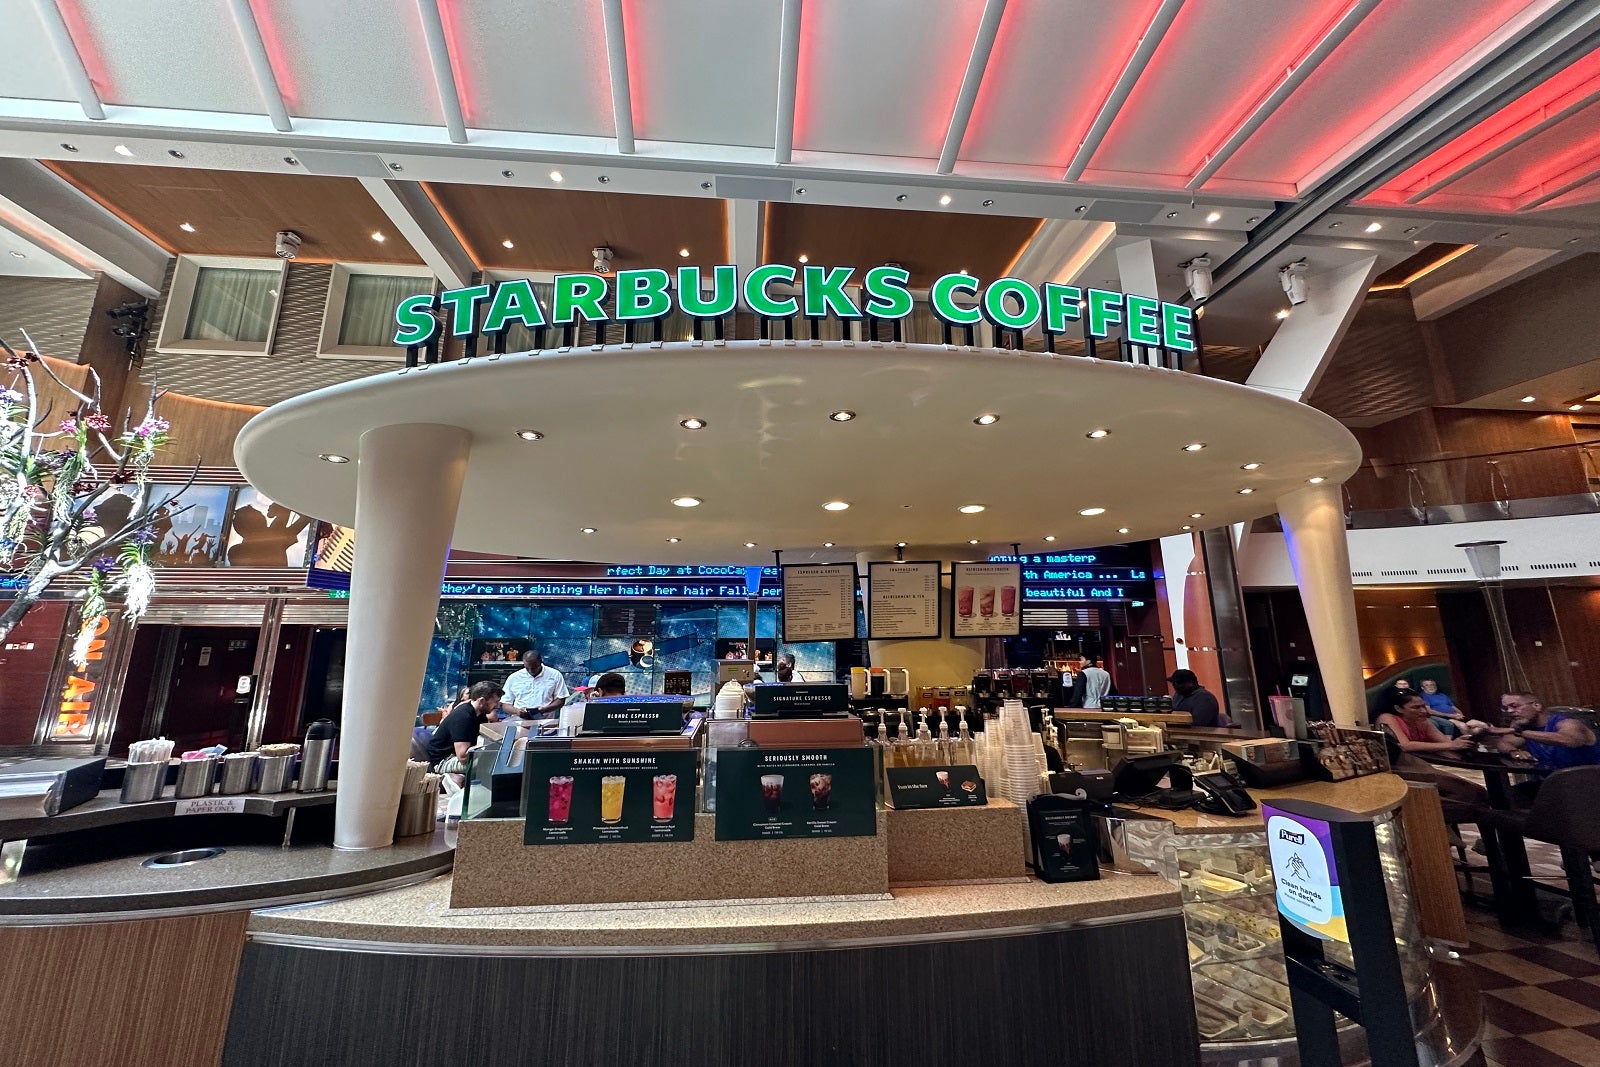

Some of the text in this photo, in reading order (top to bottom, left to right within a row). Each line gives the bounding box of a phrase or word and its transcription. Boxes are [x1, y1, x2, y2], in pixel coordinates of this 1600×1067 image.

[393, 263, 1195, 353] STARBUCKS COFFEE
[1046, 554, 1097, 564] masterp
[649, 566, 671, 576] Day
[676, 566, 692, 575] at
[1043, 570, 1093, 579] America
[1131, 569, 1146, 579] La
[441, 583, 494, 595] they're
[499, 584, 524, 594] not
[529, 584, 583, 596] shining
[589, 585, 613, 595] Her
[618, 585, 649, 595] hair
[654, 585, 678, 595] her
[683, 585, 714, 595] hair
[1026, 587, 1124, 597] beautiful And I
[603, 757, 620, 765] WITH
[190, 799, 225, 807] PLASTIC
[185, 806, 213, 814] PAPER
[1280, 829, 1304, 845] Purell
[1281, 878, 1322, 900] Clean hands
[1288, 888, 1315, 904] on deck
